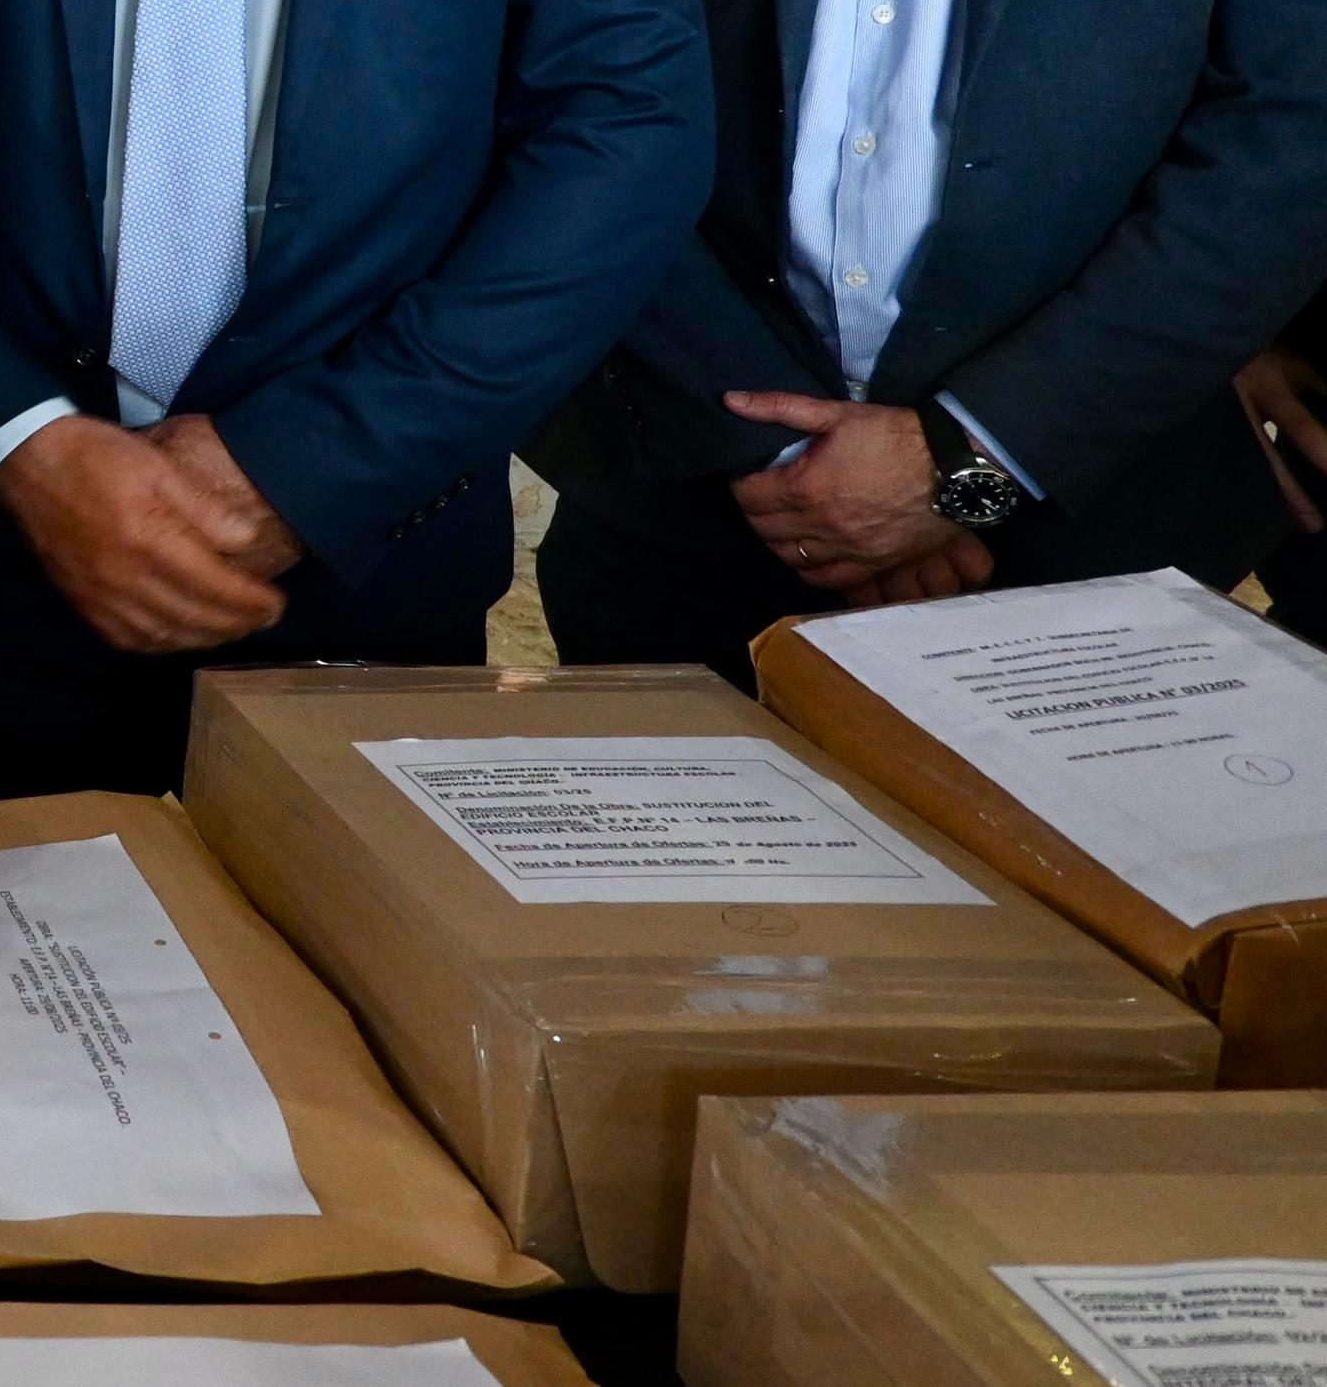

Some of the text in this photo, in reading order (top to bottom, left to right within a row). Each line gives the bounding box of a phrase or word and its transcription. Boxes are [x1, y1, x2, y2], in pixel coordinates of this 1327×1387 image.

[1005, 701, 1094, 719] LICITACION
[1095, 691, 1159, 709] PUBLICA
[607, 824, 668, 832] CHACO
